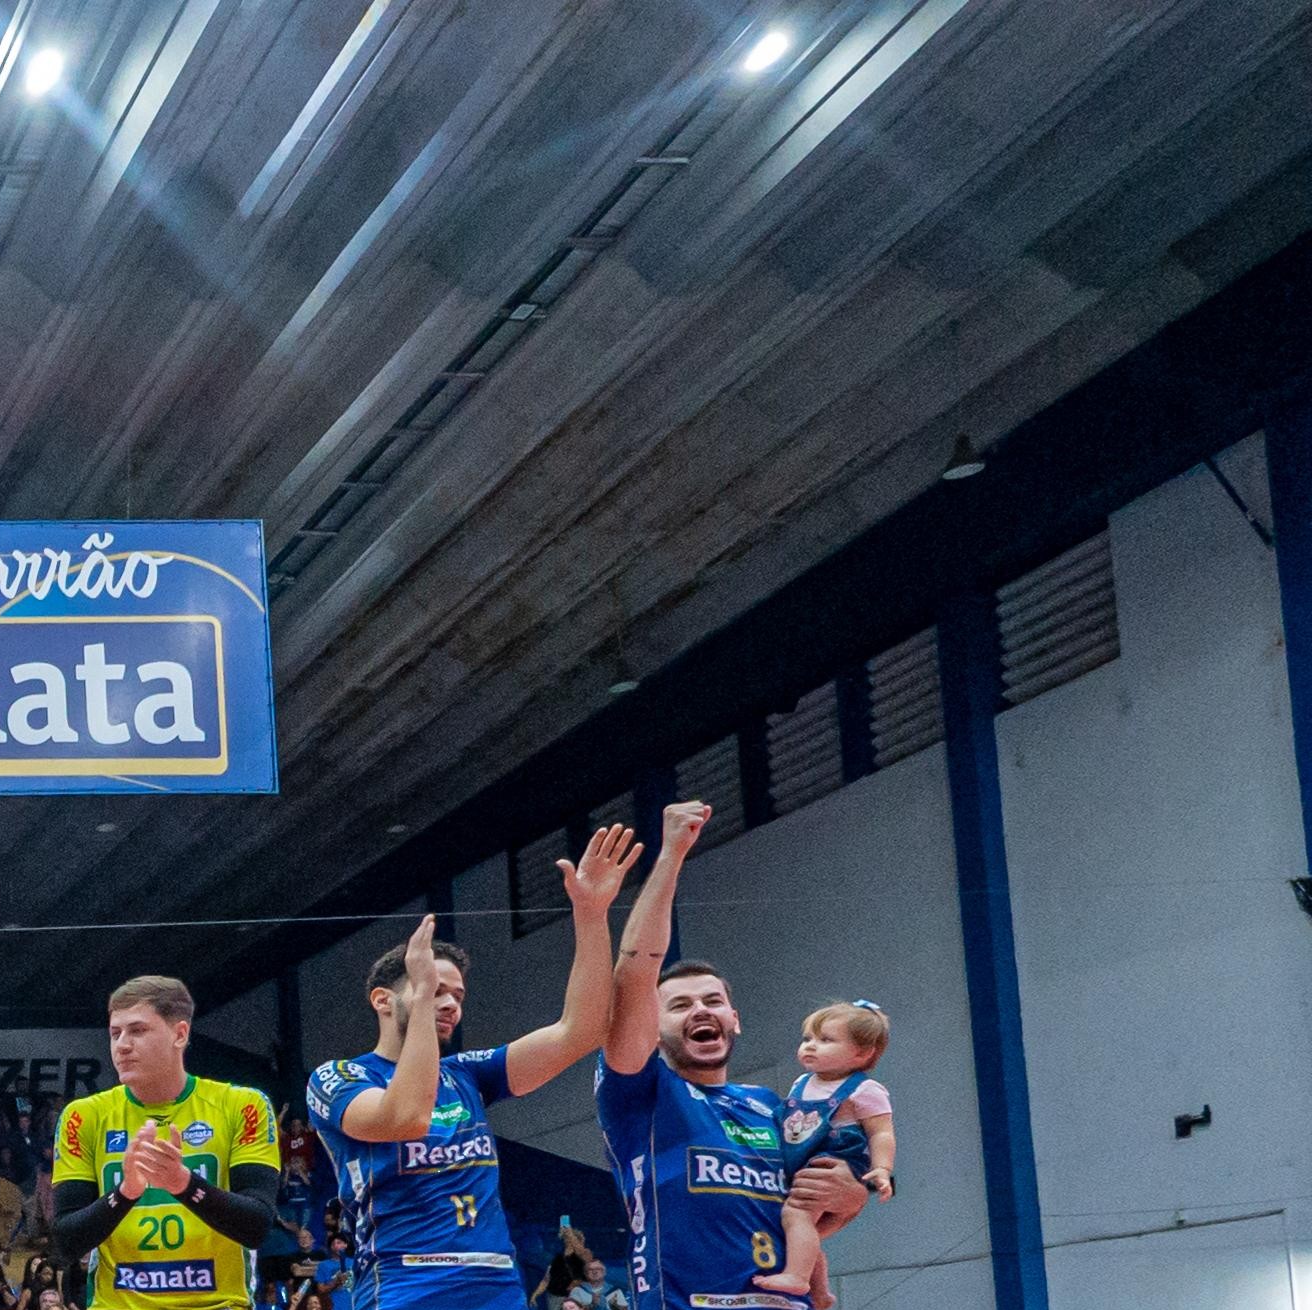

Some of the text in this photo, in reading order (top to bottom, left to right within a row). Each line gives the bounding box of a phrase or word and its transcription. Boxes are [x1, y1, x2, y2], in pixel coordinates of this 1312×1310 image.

[695, 1155, 789, 1195] Renat
[137, 1214, 185, 1251] 20
[751, 1231, 776, 1269] 8
[117, 1266, 212, 1289] Renata
[418, 1255, 459, 1264] SICOOB
[633, 1234, 650, 1293] PUC
